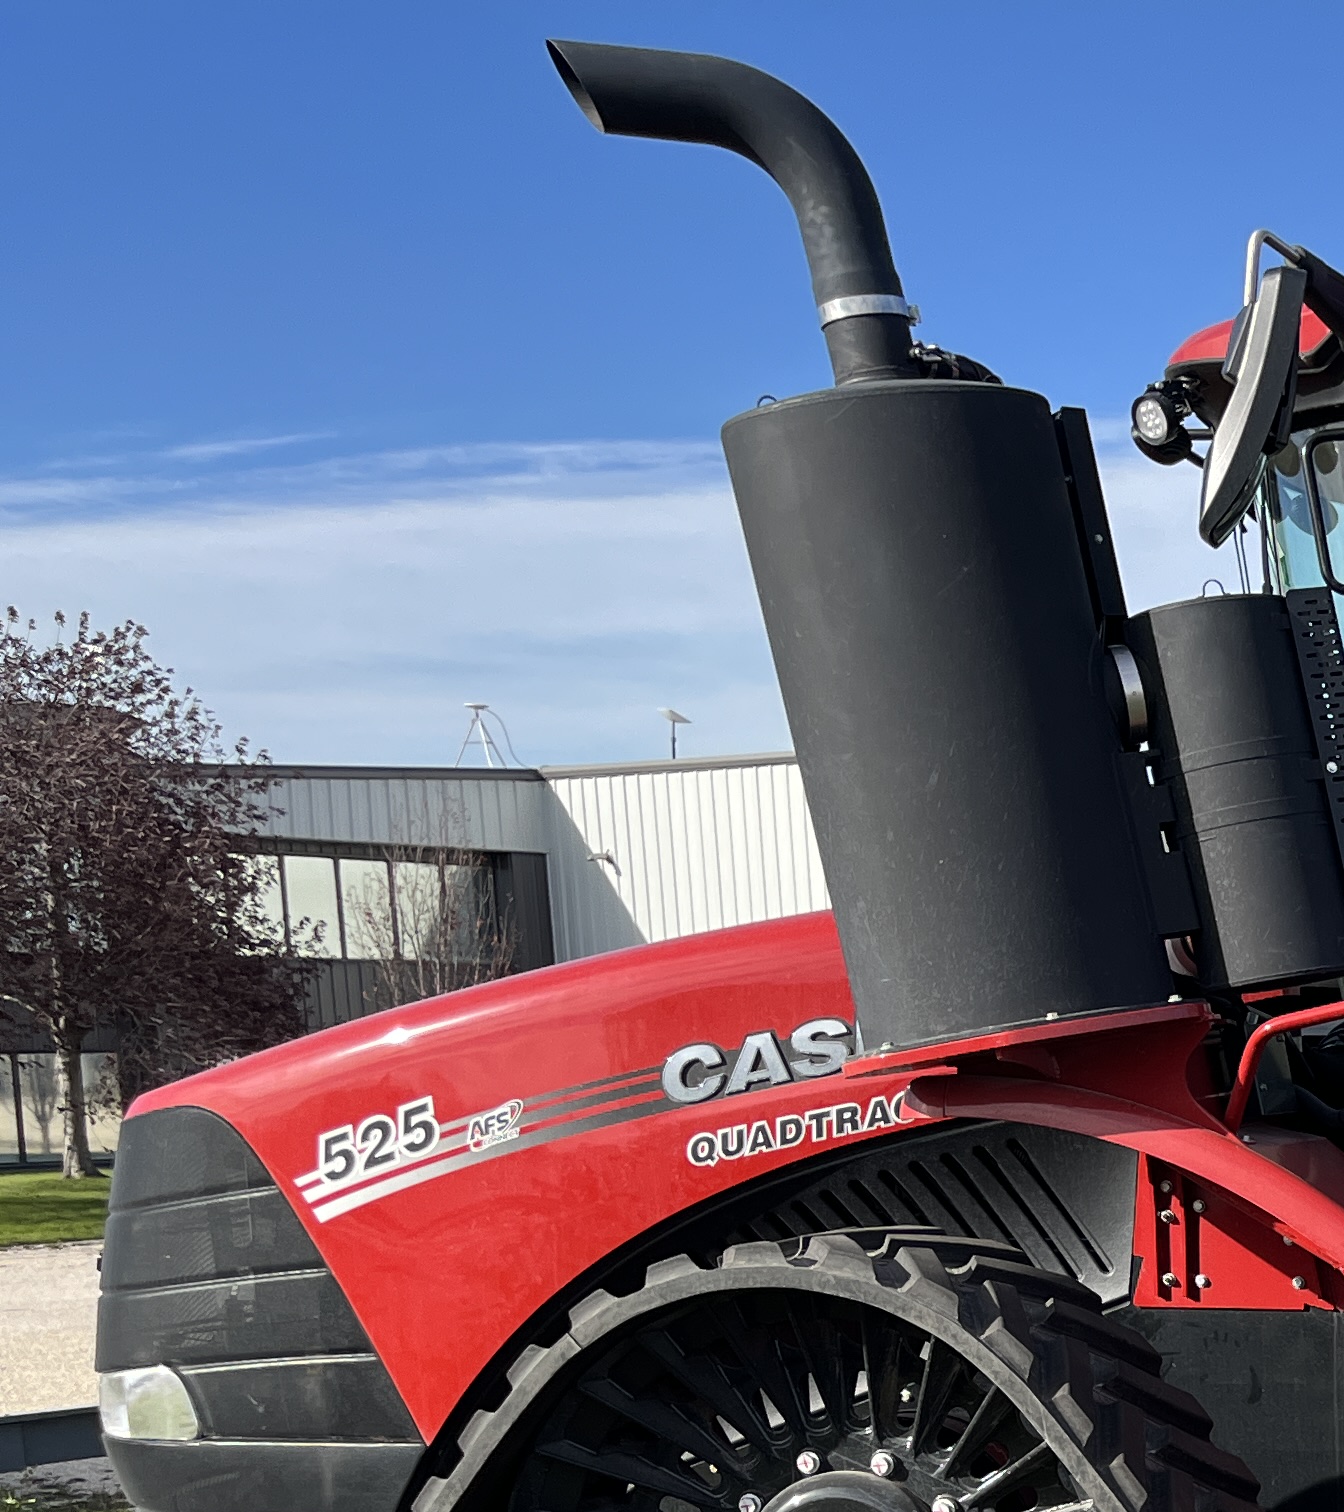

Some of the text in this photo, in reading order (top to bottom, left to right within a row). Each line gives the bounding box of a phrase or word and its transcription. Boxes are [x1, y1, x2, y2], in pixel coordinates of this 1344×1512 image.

[661, 1017, 864, 1103] CAS
[319, 1096, 440, 1183] 525
[469, 1111, 509, 1141] AFS
